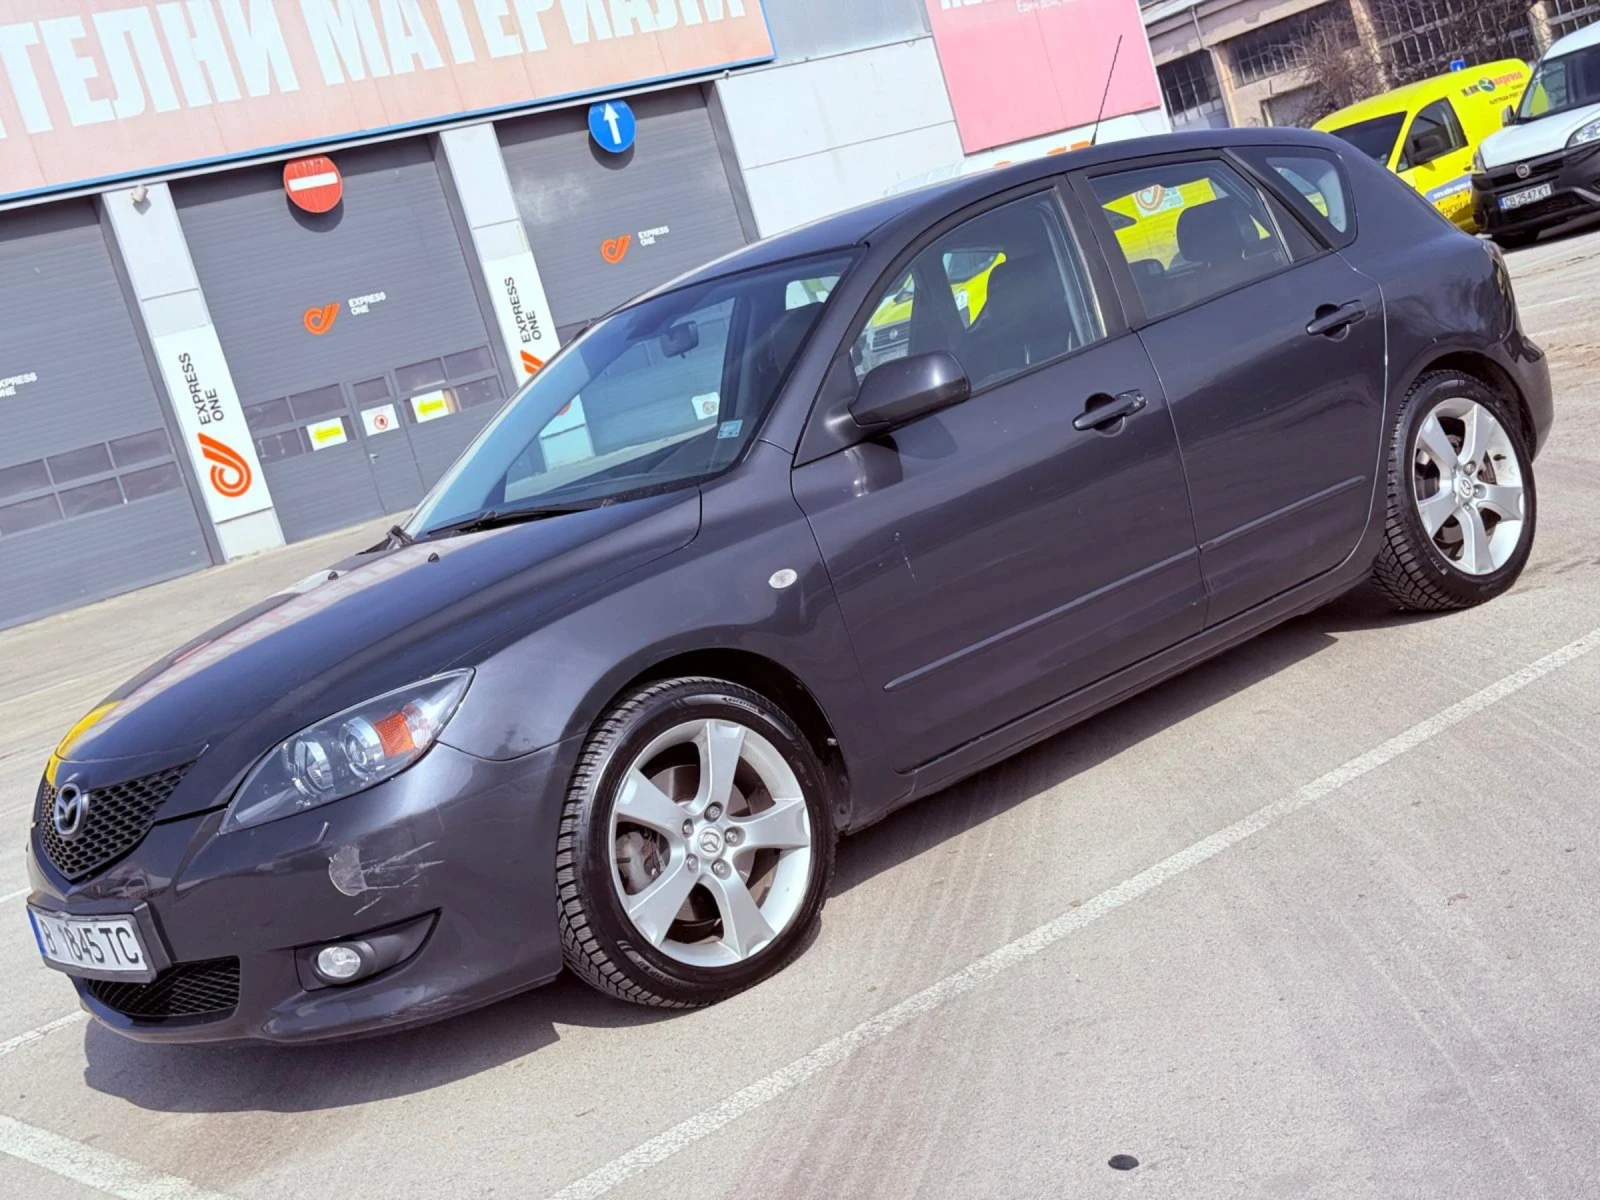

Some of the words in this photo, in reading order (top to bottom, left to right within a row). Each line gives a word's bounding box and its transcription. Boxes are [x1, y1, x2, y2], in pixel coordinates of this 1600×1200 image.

[0, 0, 300, 139] ТЕЛНИ
[300, 0, 746, 86] МАТЕРИ
[640, 235, 656, 246] ONE
[348, 291, 387, 308] EXPRESS
[350, 304, 370, 315] ONE
[504, 276, 532, 344] EXPRESS
[525, 310, 542, 341] ONE
[178, 352, 212, 425] EXPRESS
[204, 387, 225, 421] ONE
[39, 918, 58, 955] B
[57, 924, 105, 964] 1845
[97, 926, 140, 965] TC
